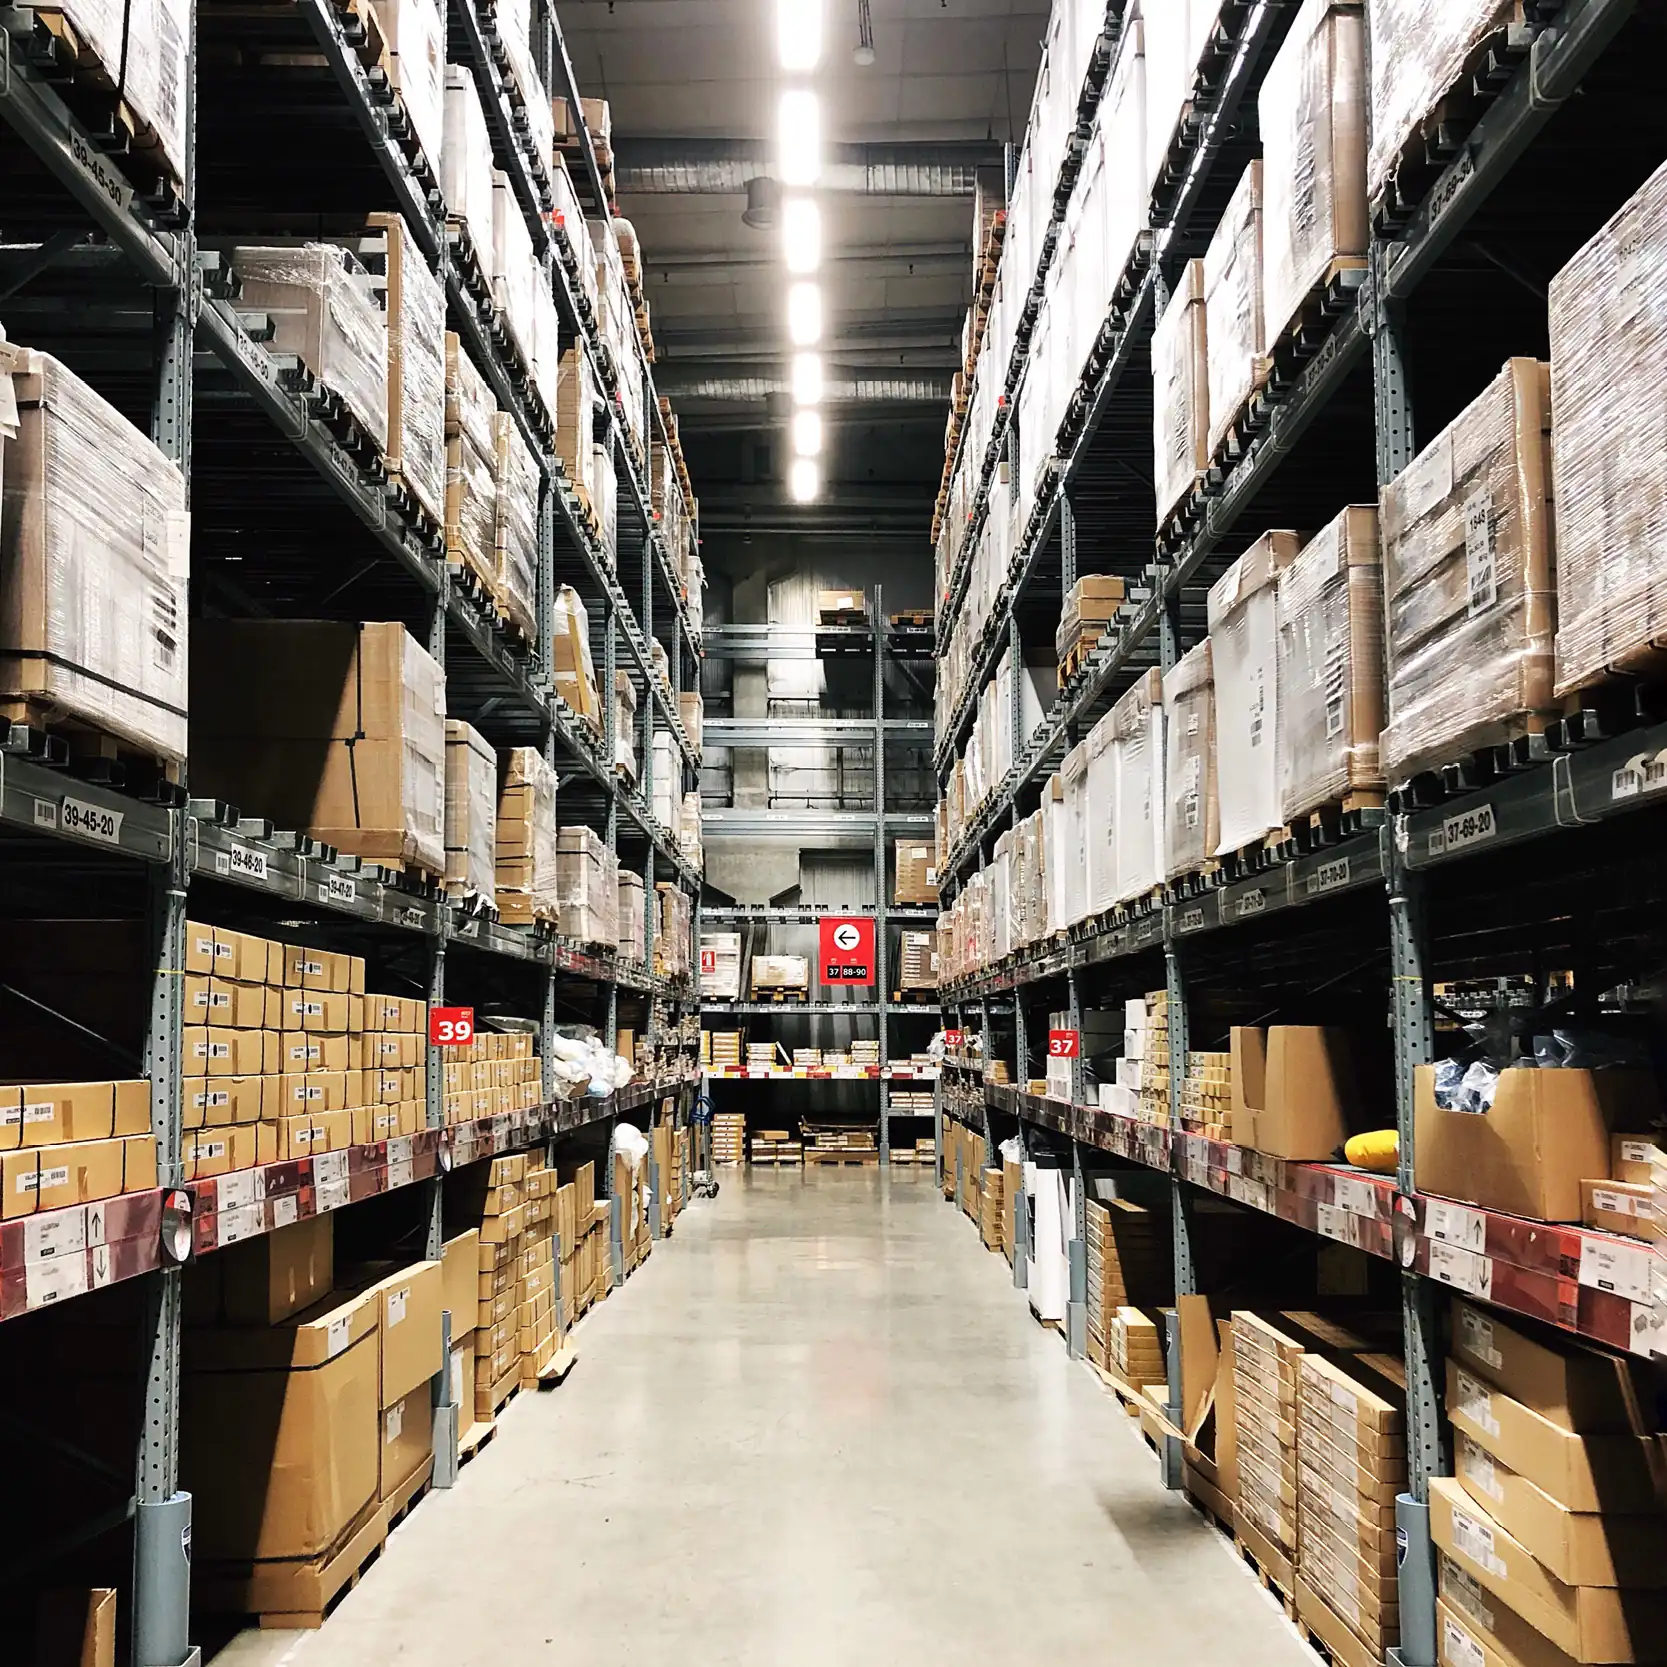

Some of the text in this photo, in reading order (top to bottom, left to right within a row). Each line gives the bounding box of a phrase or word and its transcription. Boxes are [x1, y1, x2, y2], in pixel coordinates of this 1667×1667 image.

[74, 138, 122, 207] 39-45-30
[64, 804, 114, 836] 39-45-20
[1447, 810, 1491, 843] 37-69-20
[232, 849, 263, 873] 39-46-20
[828, 968, 867, 976] 37 88-90
[438, 1020, 471, 1041] 39
[948, 1035, 962, 1044] 37
[1051, 1039, 1074, 1054] 37
